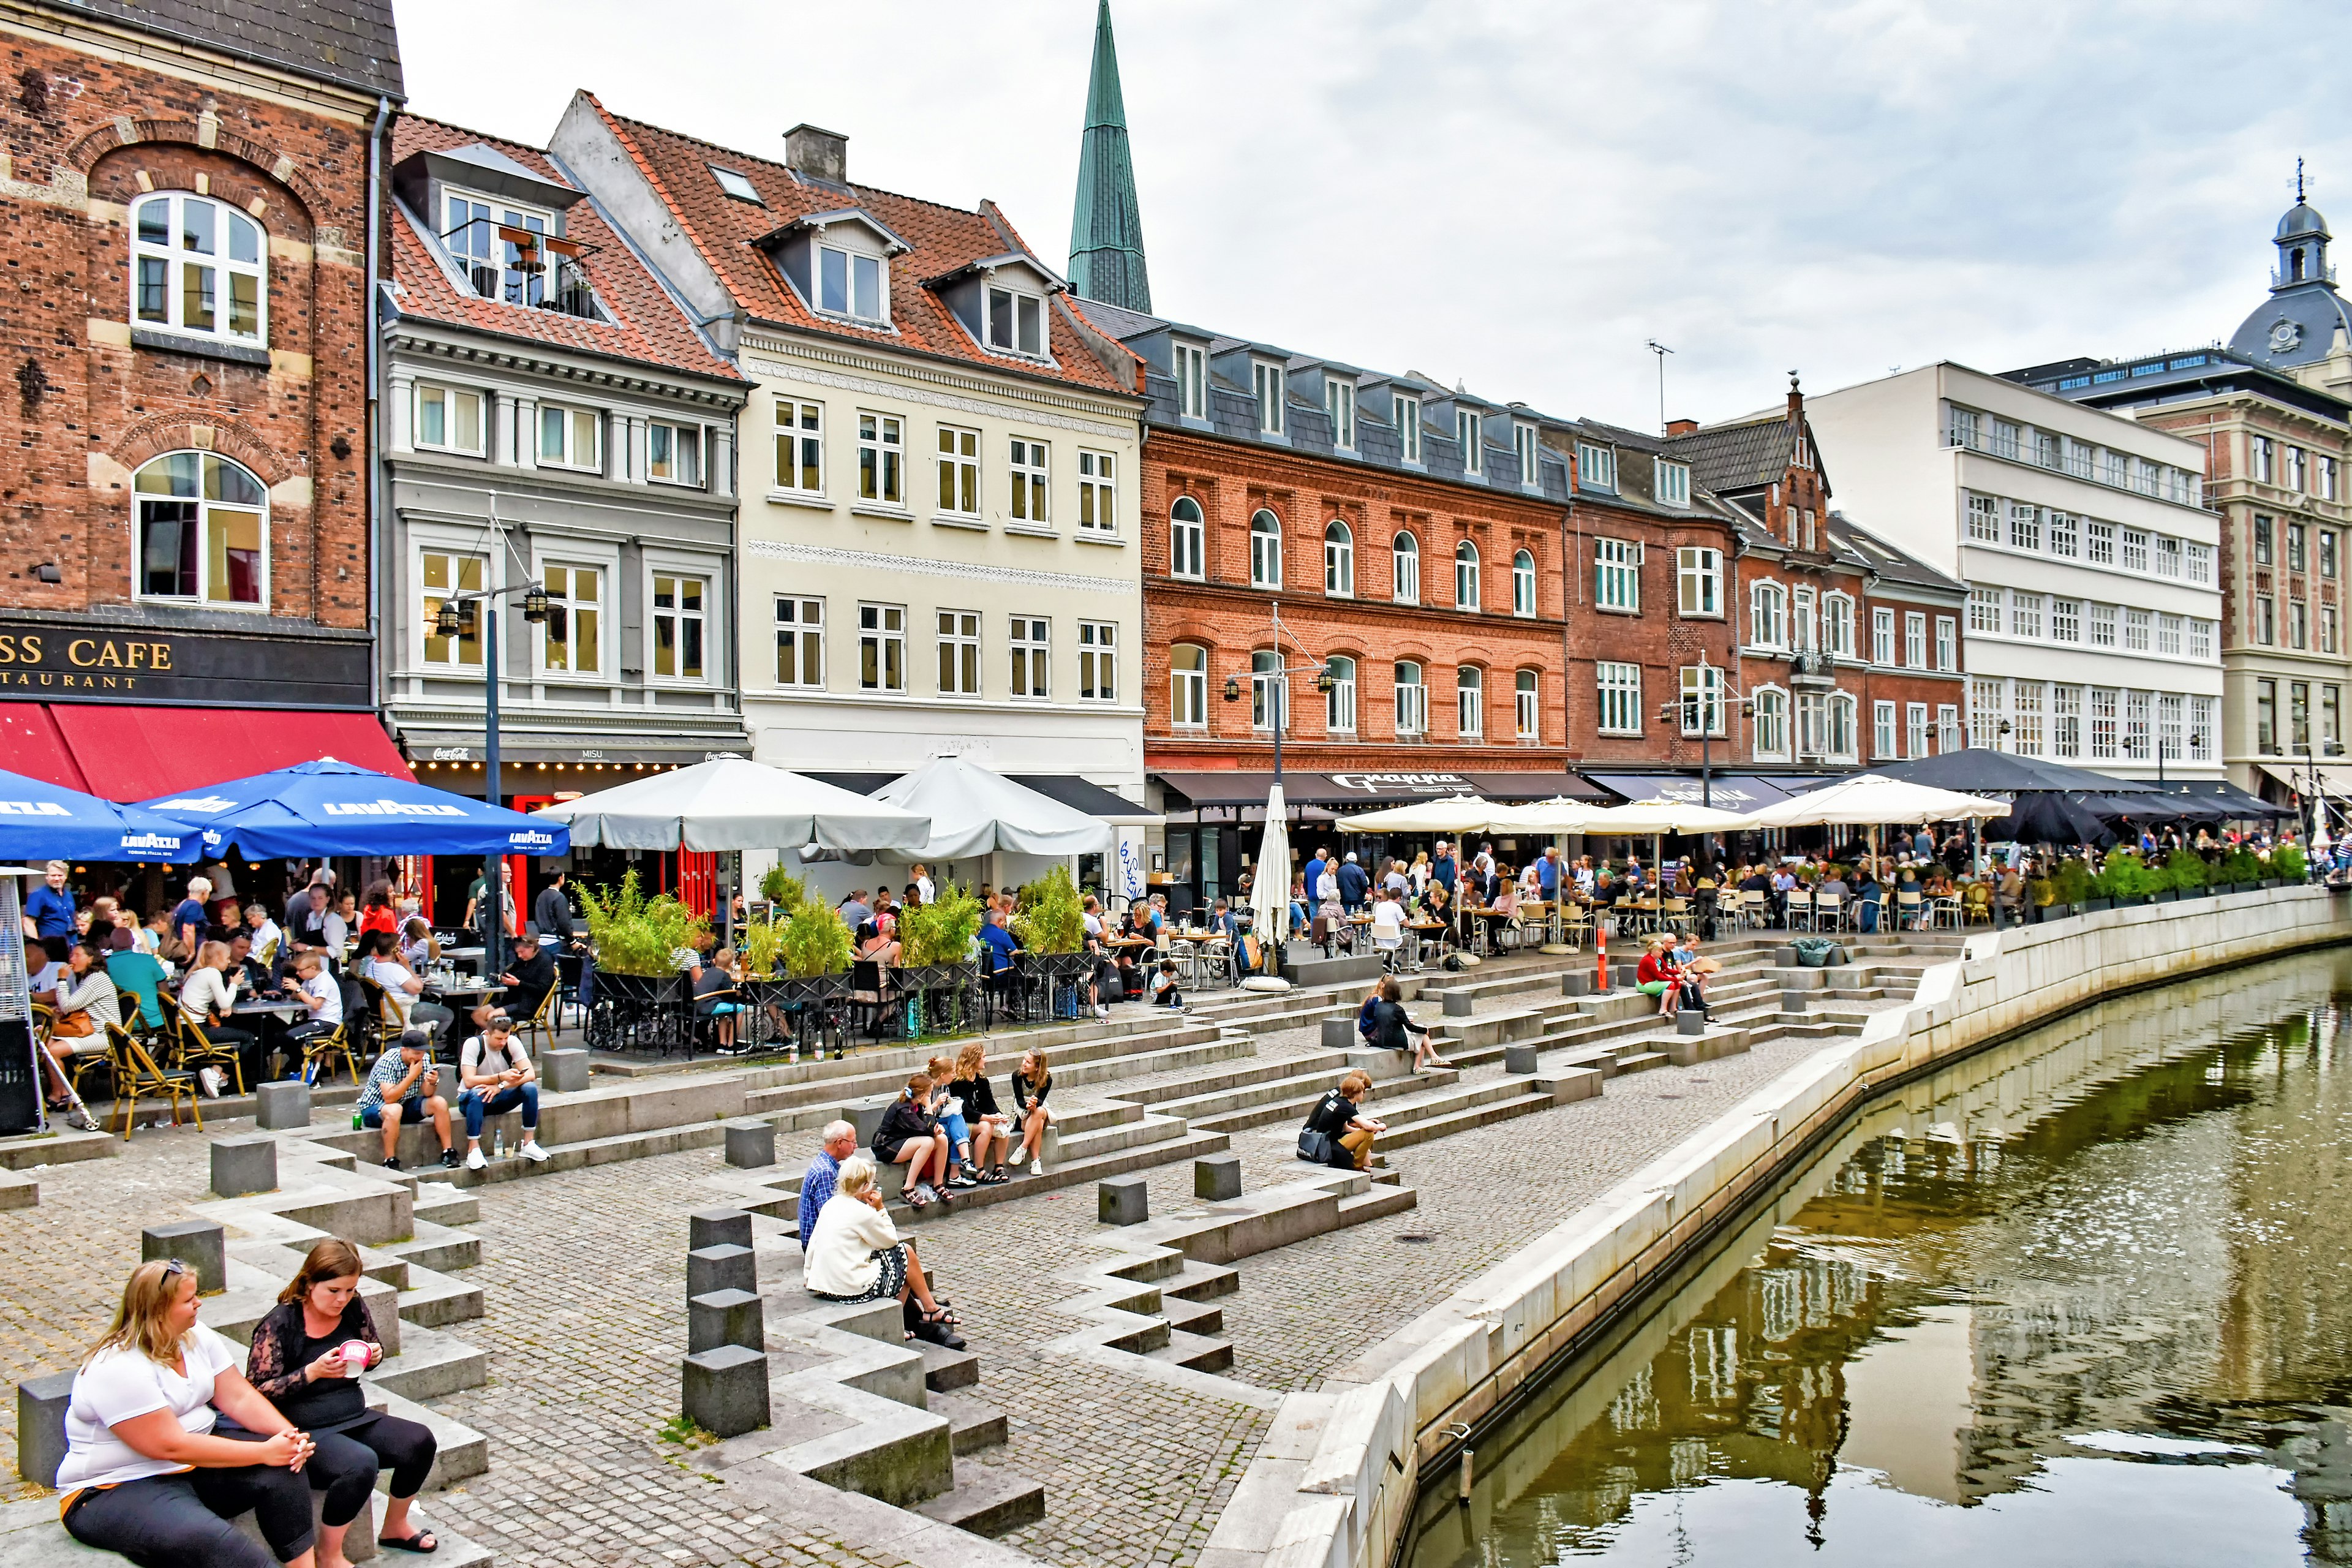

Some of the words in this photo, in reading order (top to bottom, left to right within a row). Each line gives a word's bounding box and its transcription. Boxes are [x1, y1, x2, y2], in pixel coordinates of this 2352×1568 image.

[0, 635, 42, 663] SS
[68, 639, 172, 670] CAFE
[0, 672, 136, 689] TAURANT
[433, 747, 469, 760] Coca-Cola
[1332, 774, 1463, 793] Grappa
[323, 799, 470, 816] LAVAZZA
[121, 833, 180, 849] LAVAZZA
[509, 830, 552, 844] LAVAZZA
[434, 932, 456, 946] Carlsberg
